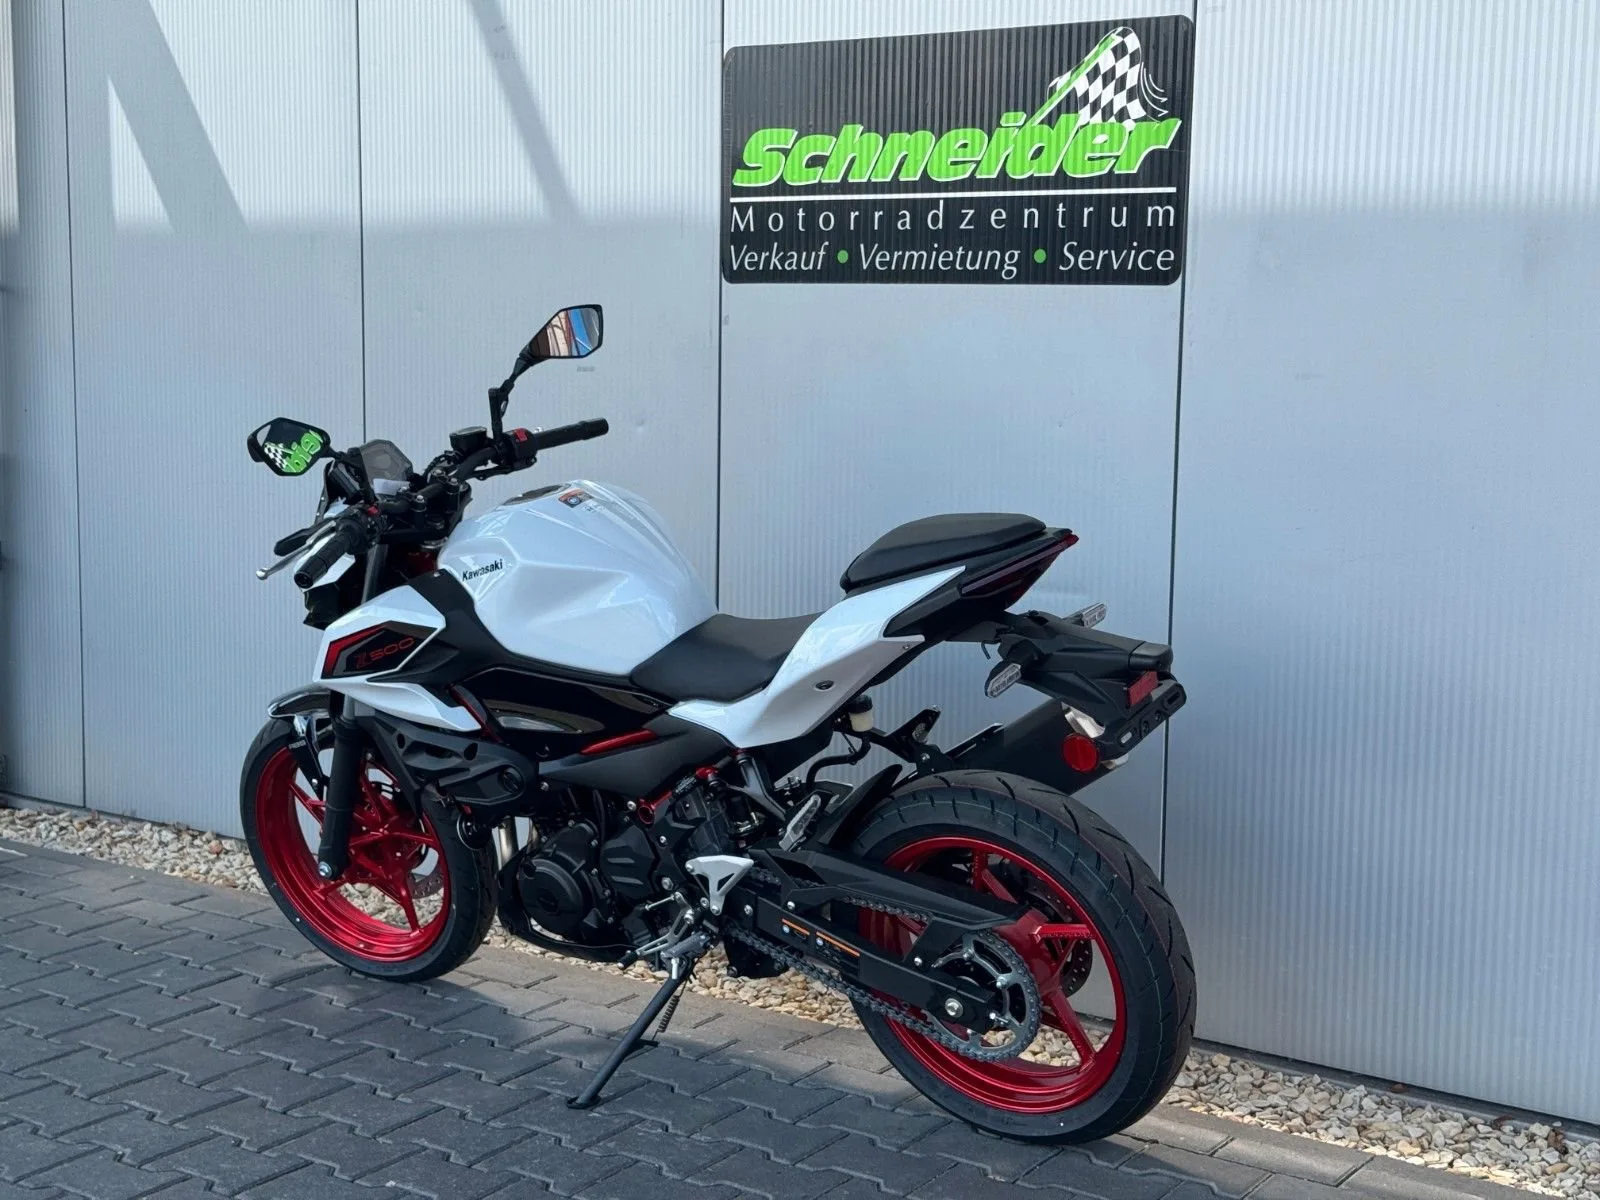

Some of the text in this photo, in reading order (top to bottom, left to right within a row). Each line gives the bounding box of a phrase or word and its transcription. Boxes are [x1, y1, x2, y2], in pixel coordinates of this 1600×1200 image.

[732, 112, 1182, 187] Schneider
[730, 200, 1175, 232] Motorradzentrum
[730, 241, 1175, 280] Verkauf Vermietung Service
[462, 558, 503, 582] Kawasaki
